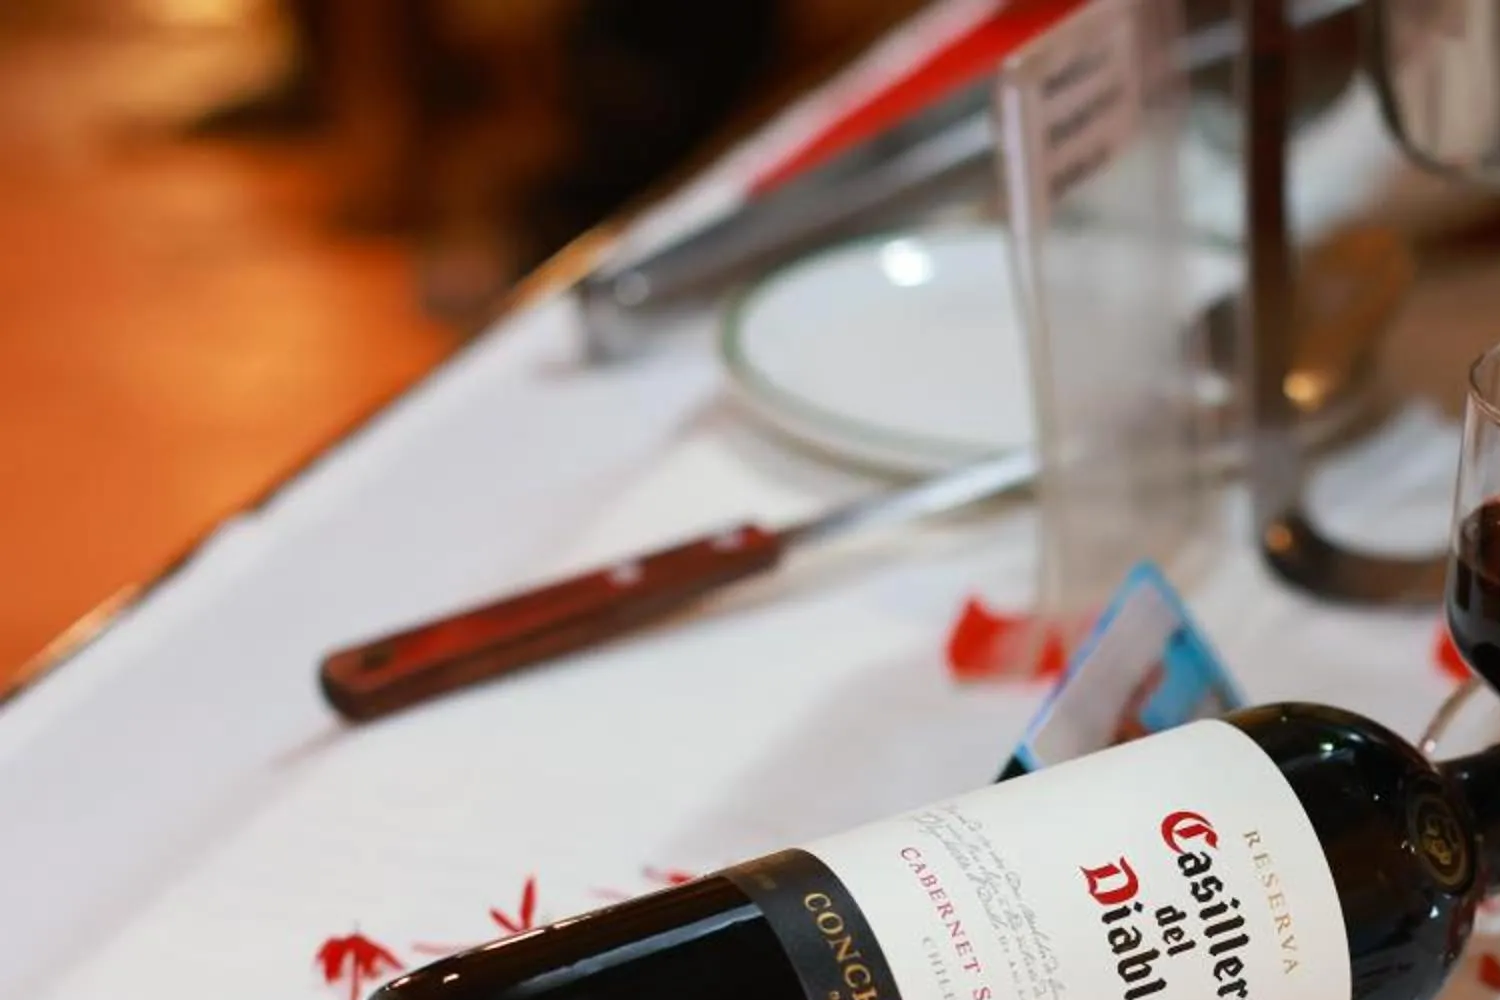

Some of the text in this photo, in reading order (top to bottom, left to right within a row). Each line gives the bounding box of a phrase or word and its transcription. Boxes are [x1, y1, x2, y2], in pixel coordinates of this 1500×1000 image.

[901, 846, 981, 974] CABERNET
[1154, 904, 1197, 957] del
[1243, 830, 1300, 974] RESERVA
